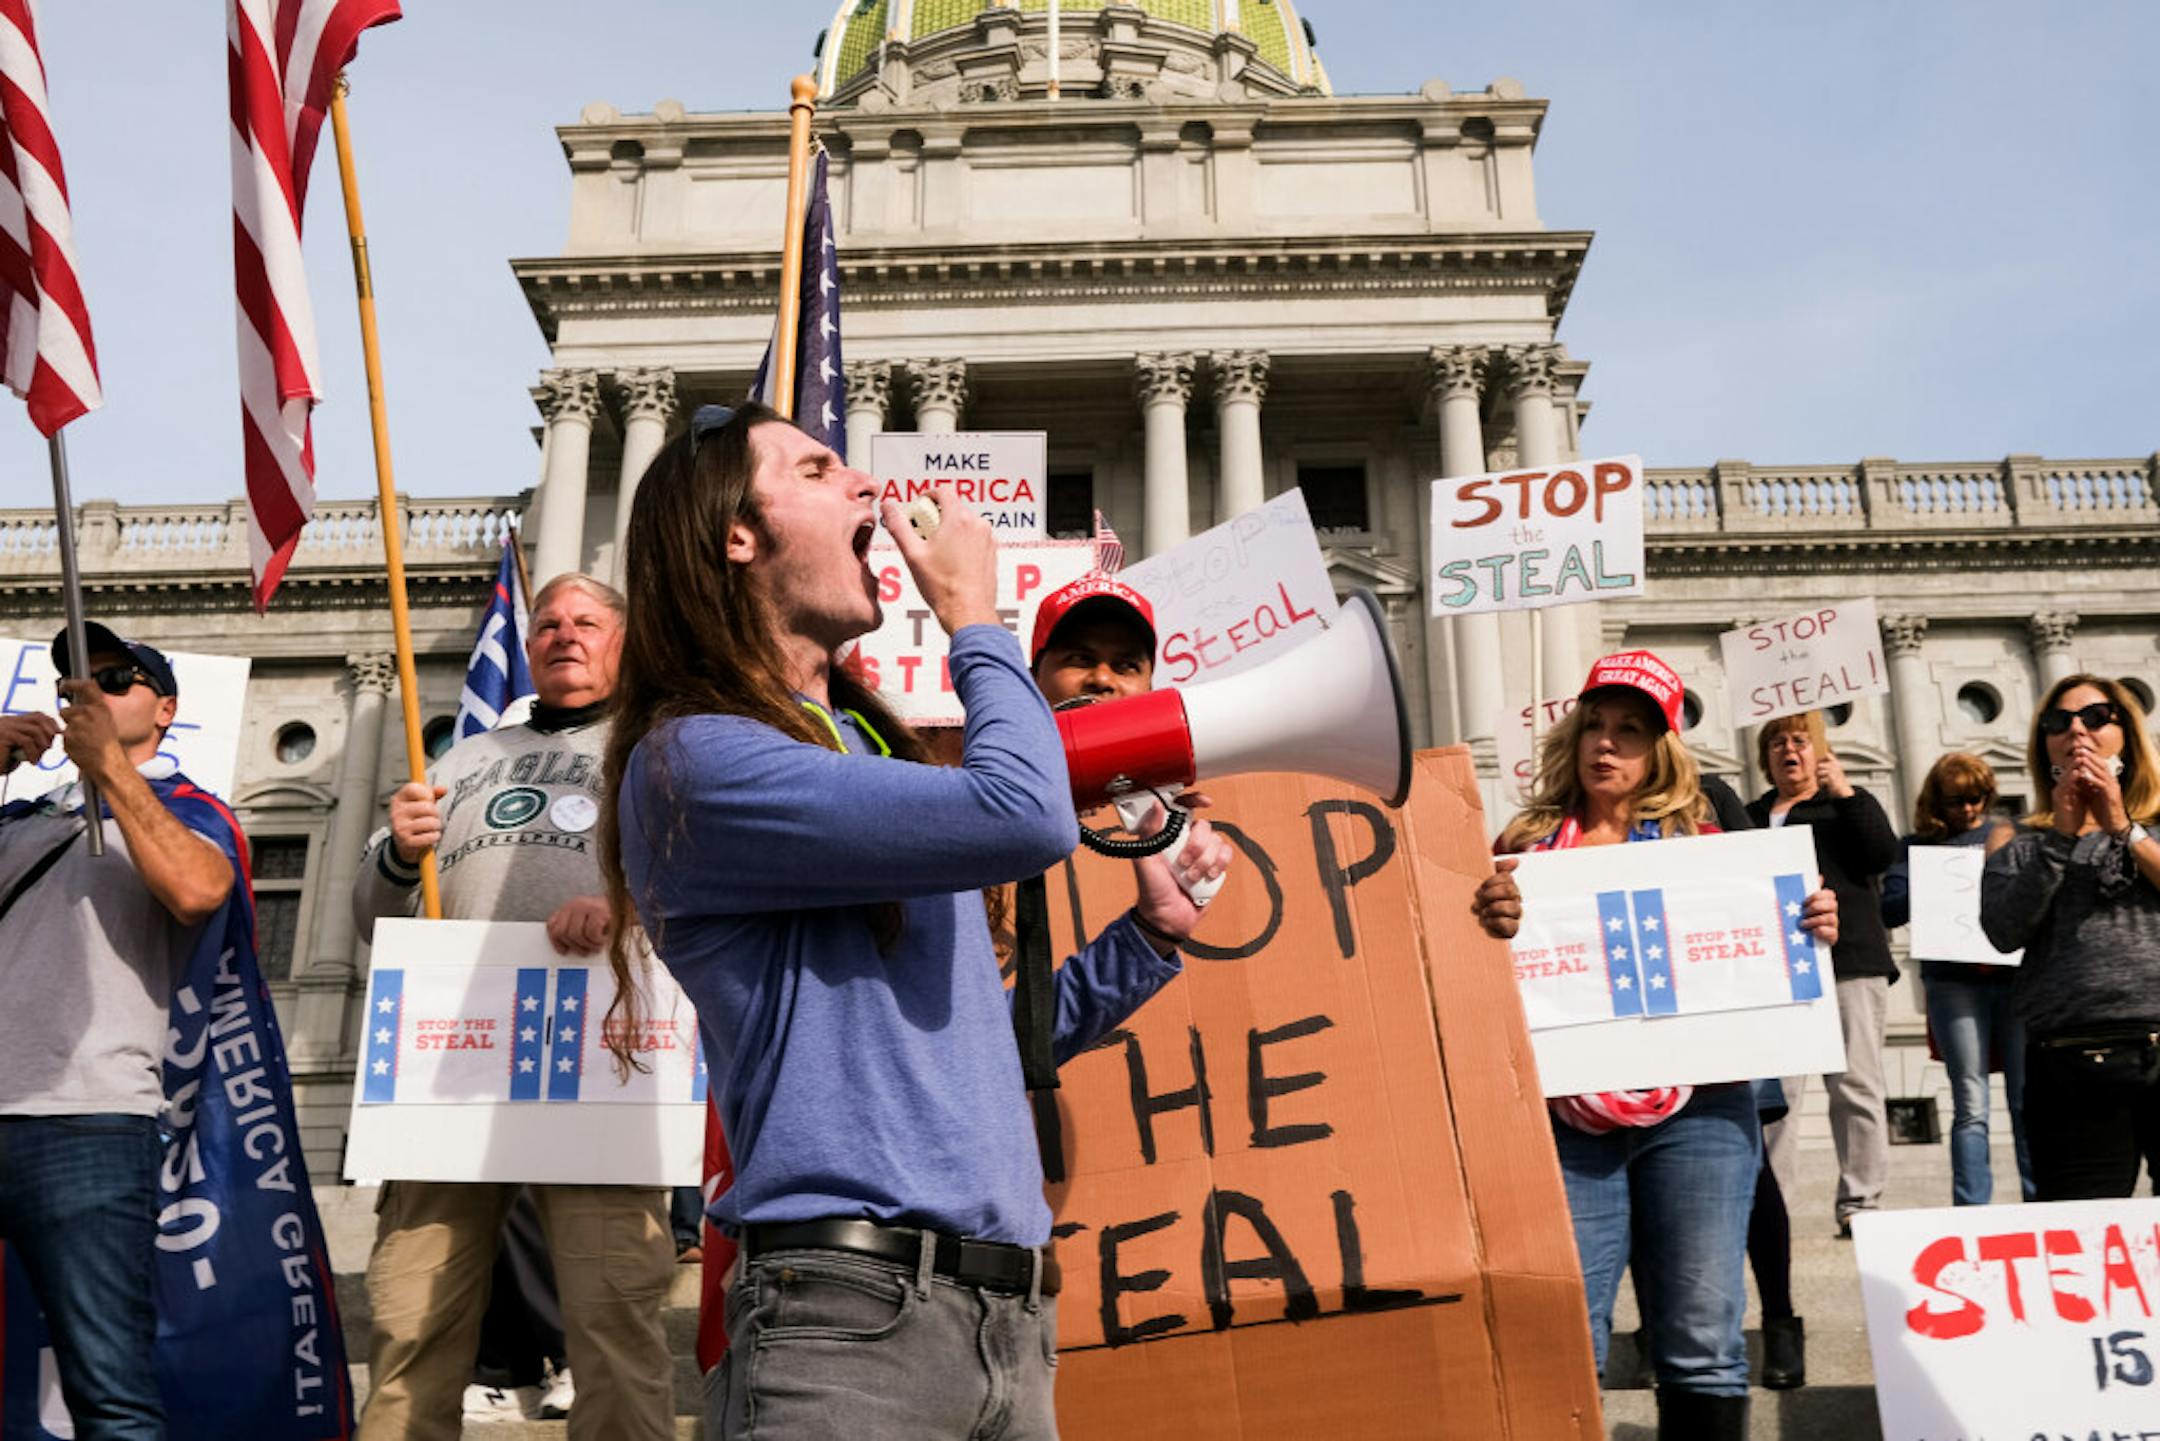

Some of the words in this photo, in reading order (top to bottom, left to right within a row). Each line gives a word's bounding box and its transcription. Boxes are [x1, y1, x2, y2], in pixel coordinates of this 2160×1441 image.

[925, 453, 990, 470] MAKE
[1452, 462, 1632, 527] STOP
[980, 512, 1036, 528] GAIN
[1509, 525, 1544, 544] the
[879, 565, 1041, 602] SP
[1439, 540, 1634, 607] STEAL
[906, 609, 1019, 646] TE
[1749, 609, 1836, 651] STOP
[1780, 651, 1809, 663] the
[1520, 698, 1580, 727] STO
[996, 799, 1396, 981] TOP
[1685, 931, 1724, 943] STOP
[1731, 926, 1763, 940] THE
[1555, 943, 1586, 956] THE
[1687, 941, 1765, 962] STEAL
[416, 1019, 459, 1031] STOP
[463, 1018, 497, 1030] THE
[416, 1034, 496, 1050] STEAL
[1050, 1190, 1463, 1349] EAL
[1906, 1222, 2160, 1340] STEA
